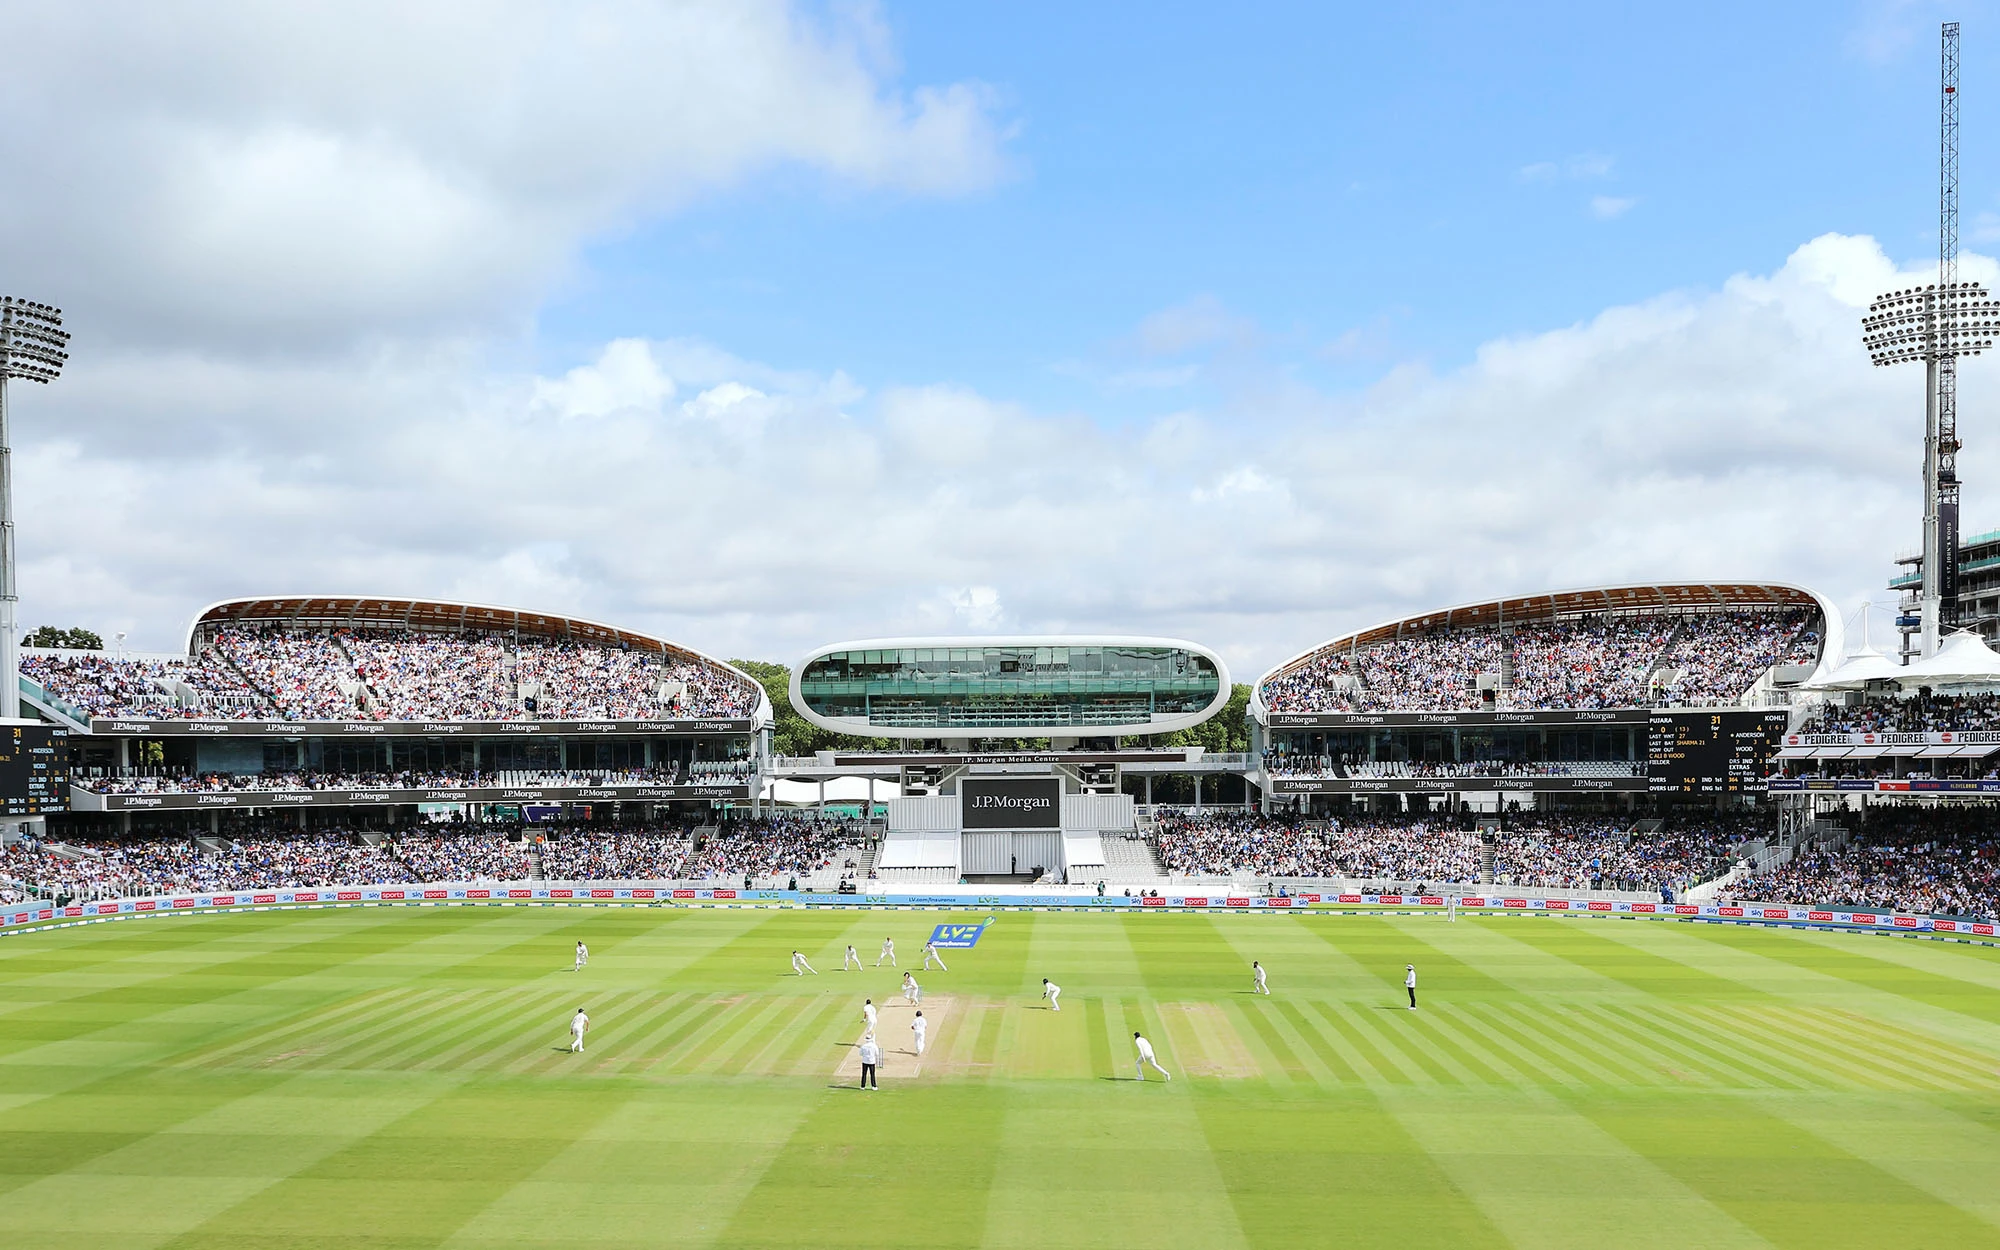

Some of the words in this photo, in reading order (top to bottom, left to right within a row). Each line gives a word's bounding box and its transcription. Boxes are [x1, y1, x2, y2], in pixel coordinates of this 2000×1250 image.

[1278, 716, 1317, 726] J.P.Morgan
[1344, 715, 1383, 725] J.P.Morgan
[1417, 714, 1456, 724] J.P.Morgan
[1494, 713, 1534, 723] J.P.Morgan
[1575, 712, 1615, 722] J.P.Morgan
[1710, 715, 1721, 725] 31
[111, 722, 150, 732] J.P.Morgan
[188, 723, 228, 733] J.P.Morgan
[265, 723, 306, 733] J.P.Morgan
[343, 723, 384, 733] J.P.Morgan
[422, 723, 463, 733] J.P.Morgan
[499, 723, 540, 733] J.P.Morgan
[576, 723, 616, 733] J.P.Morgan
[636, 722, 675, 732] J.P.Morgan
[693, 721, 732, 731] J.P.Morgan
[13, 728, 21, 738] 31
[1958, 732, 2000, 742] PEDIGREE
[1804, 735, 1847, 744] PEDIGREE
[1881, 734, 1923, 743] PEDIGREE
[15, 746, 20, 754] 2
[1283, 779, 1322, 791] J.P.Morgan
[1349, 781, 1388, 791] J.P.Morgan
[1415, 780, 1454, 790] J.P.Morgan
[1492, 779, 1533, 789] J.P.Morgan
[1571, 779, 1612, 789] J.P.Morgan
[348, 792, 389, 802] J.P.Morgan
[425, 791, 466, 801] J.P.Morgan
[501, 789, 542, 799] J.P.Morgan
[577, 789, 616, 799] J.P.Morgan
[636, 788, 675, 798] J.P.Morgan
[692, 787, 731, 797] J.P.Morgan
[123, 796, 161, 807] J.P.Morgan
[197, 794, 237, 805] J.P.Morgan
[272, 793, 313, 803] J.P.Morgan
[971, 795, 1051, 812] J.P.Morgan
[1228, 898, 1249, 906] sports
[1339, 895, 1361, 903] sports
[1462, 898, 1484, 906] sports
[136, 902, 154, 910] sports
[1720, 908, 1743, 916] sports
[1809, 912, 1831, 921] sports
[1853, 914, 1875, 923] sports
[1935, 921, 1955, 930] sports
[1973, 924, 1993, 934] sports
